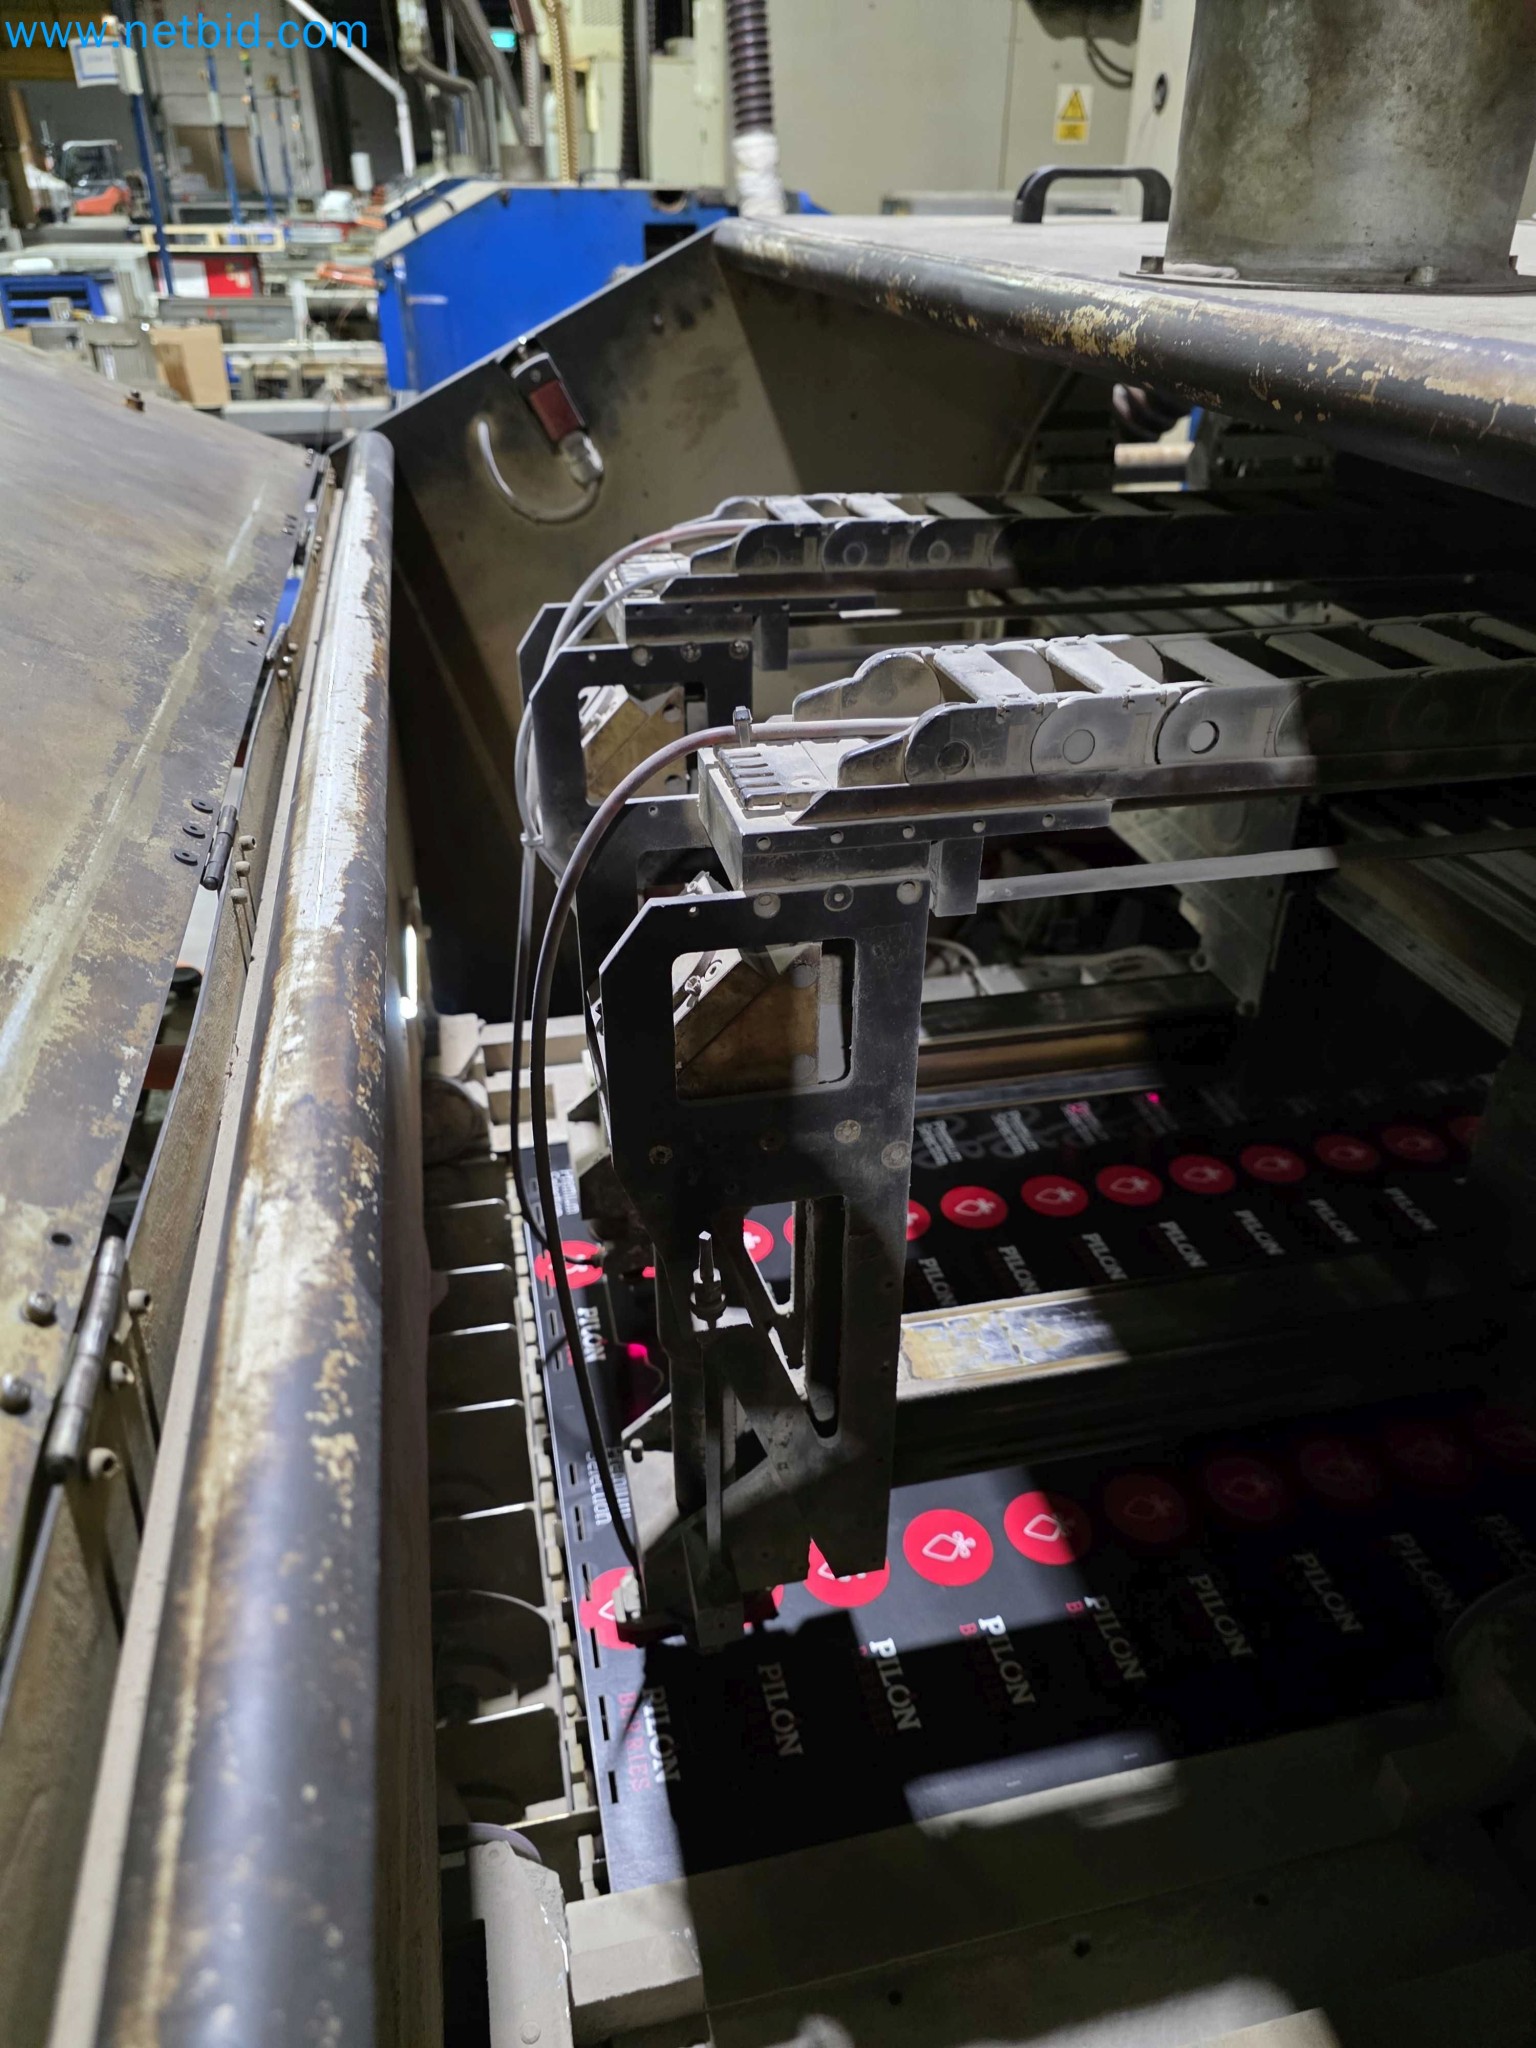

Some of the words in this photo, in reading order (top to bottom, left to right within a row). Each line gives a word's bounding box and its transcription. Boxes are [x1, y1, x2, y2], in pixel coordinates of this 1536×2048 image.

[869, 1637, 923, 1732] PILON
[978, 1615, 1037, 1707] PILON
[1084, 1593, 1148, 1683] PILON
[757, 1661, 804, 1757] PILON
